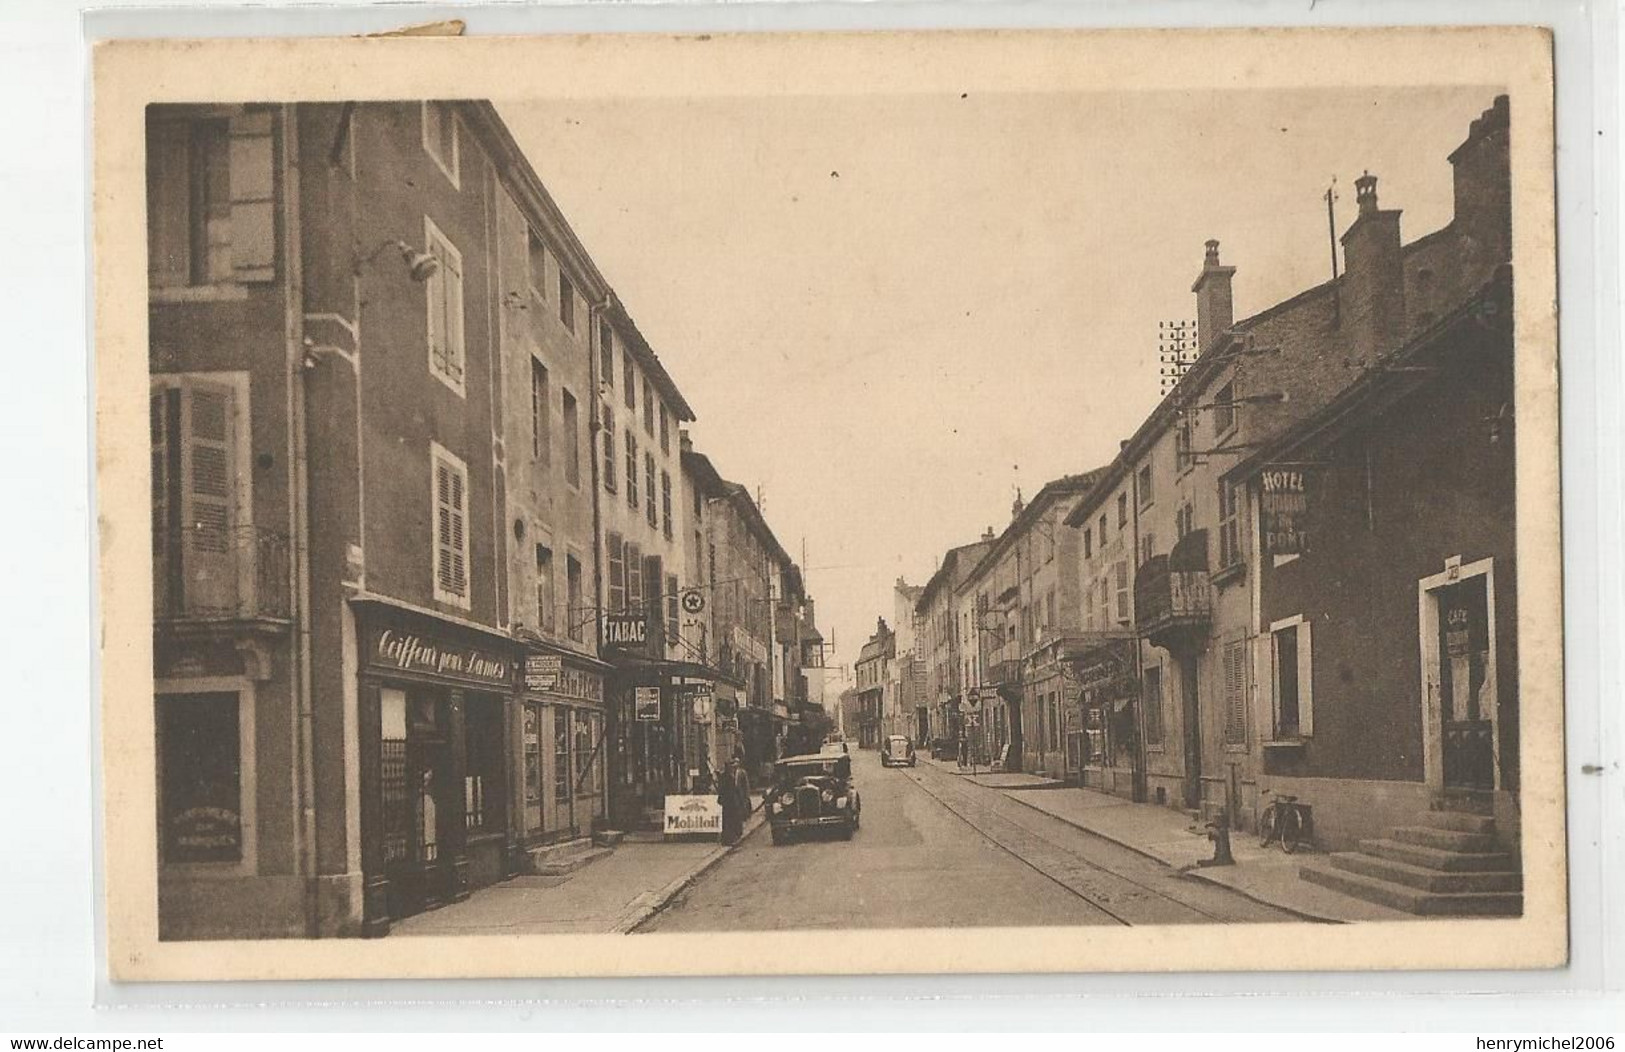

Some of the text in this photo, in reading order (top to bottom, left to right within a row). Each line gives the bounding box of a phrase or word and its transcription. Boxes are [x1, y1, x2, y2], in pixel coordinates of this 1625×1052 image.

[1261, 471, 1304, 491] HOTEL
[608, 620, 645, 642] TABAC
[379, 629, 505, 679] Coiffeur pour Dames
[667, 815, 720, 829] Mobiloil
